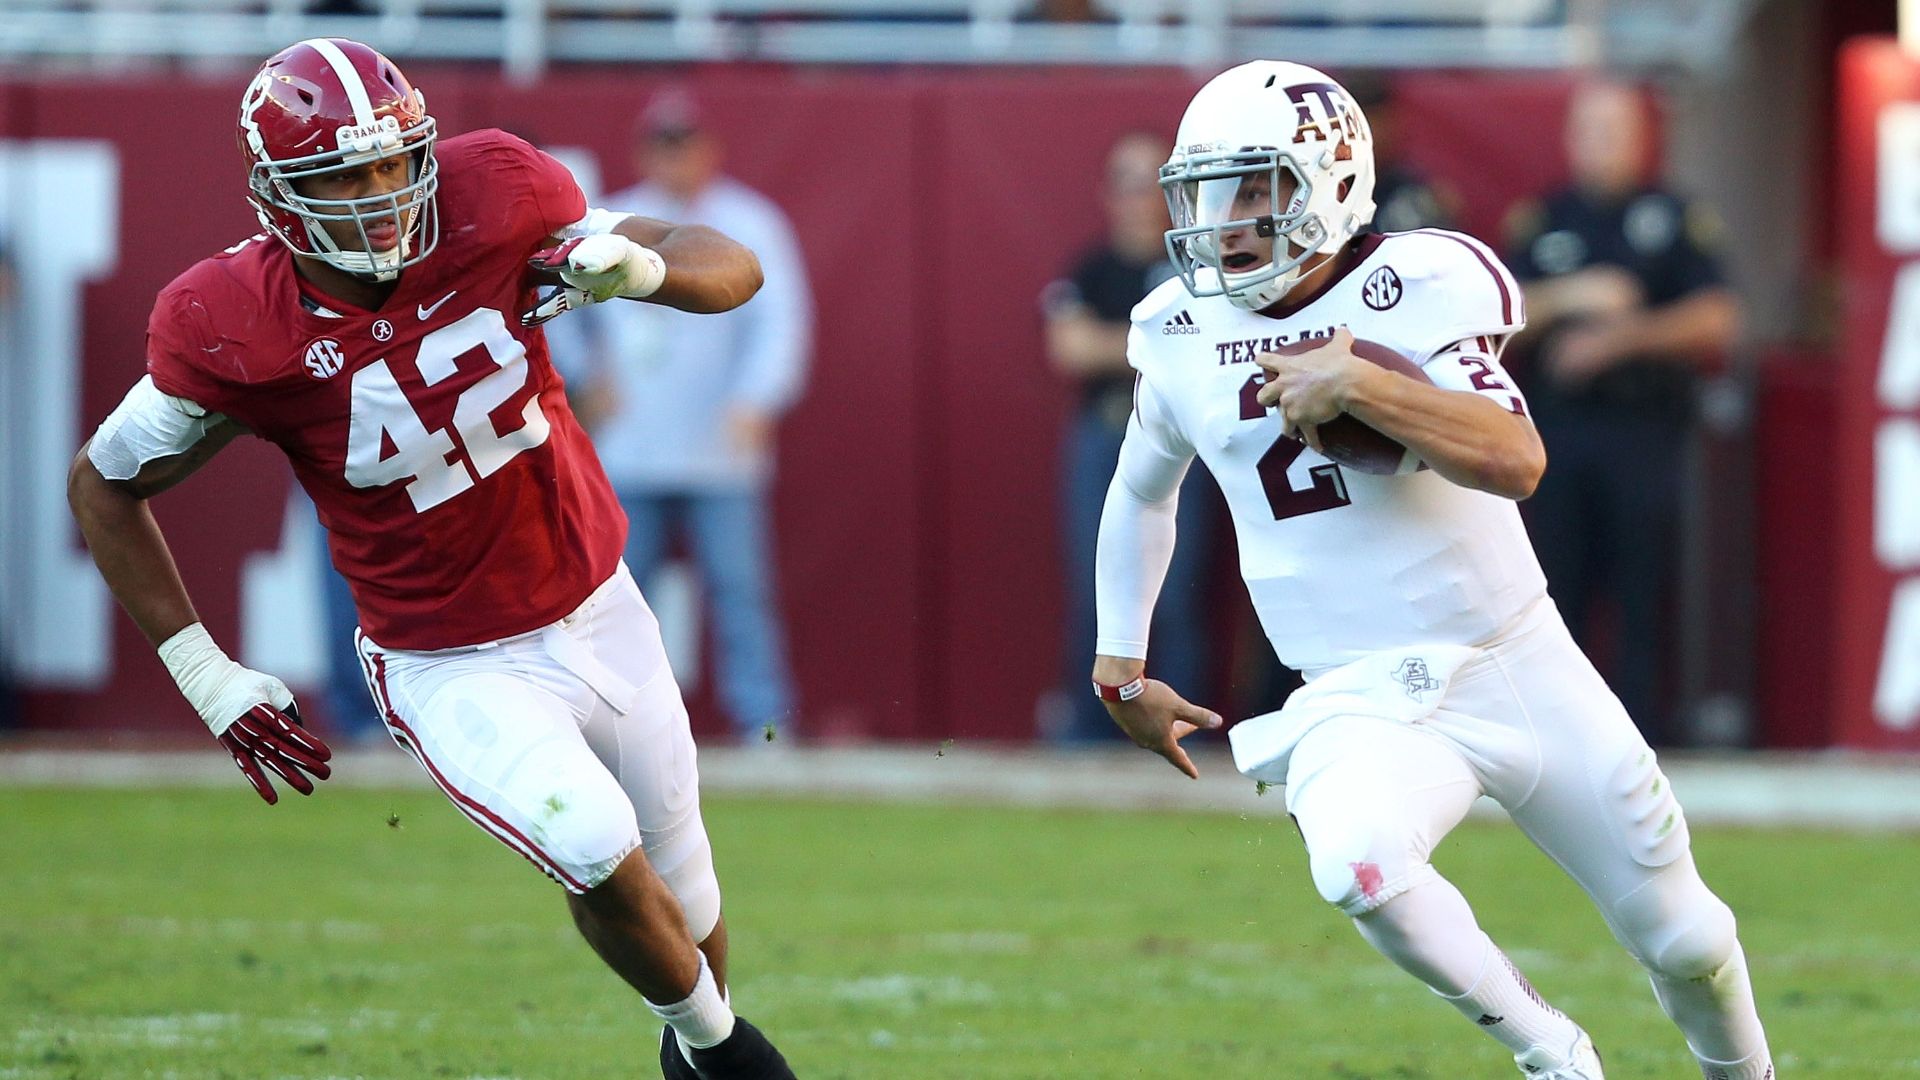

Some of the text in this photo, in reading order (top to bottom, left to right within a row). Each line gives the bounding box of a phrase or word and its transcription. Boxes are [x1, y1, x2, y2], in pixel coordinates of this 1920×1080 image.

[353, 125, 384, 138] BAMA
[1364, 266, 1400, 309] SEC
[1162, 324, 1201, 335] adidas
[305, 340, 344, 378] SEC
[1458, 356, 1509, 391] 2
[344, 307, 550, 513] 42
